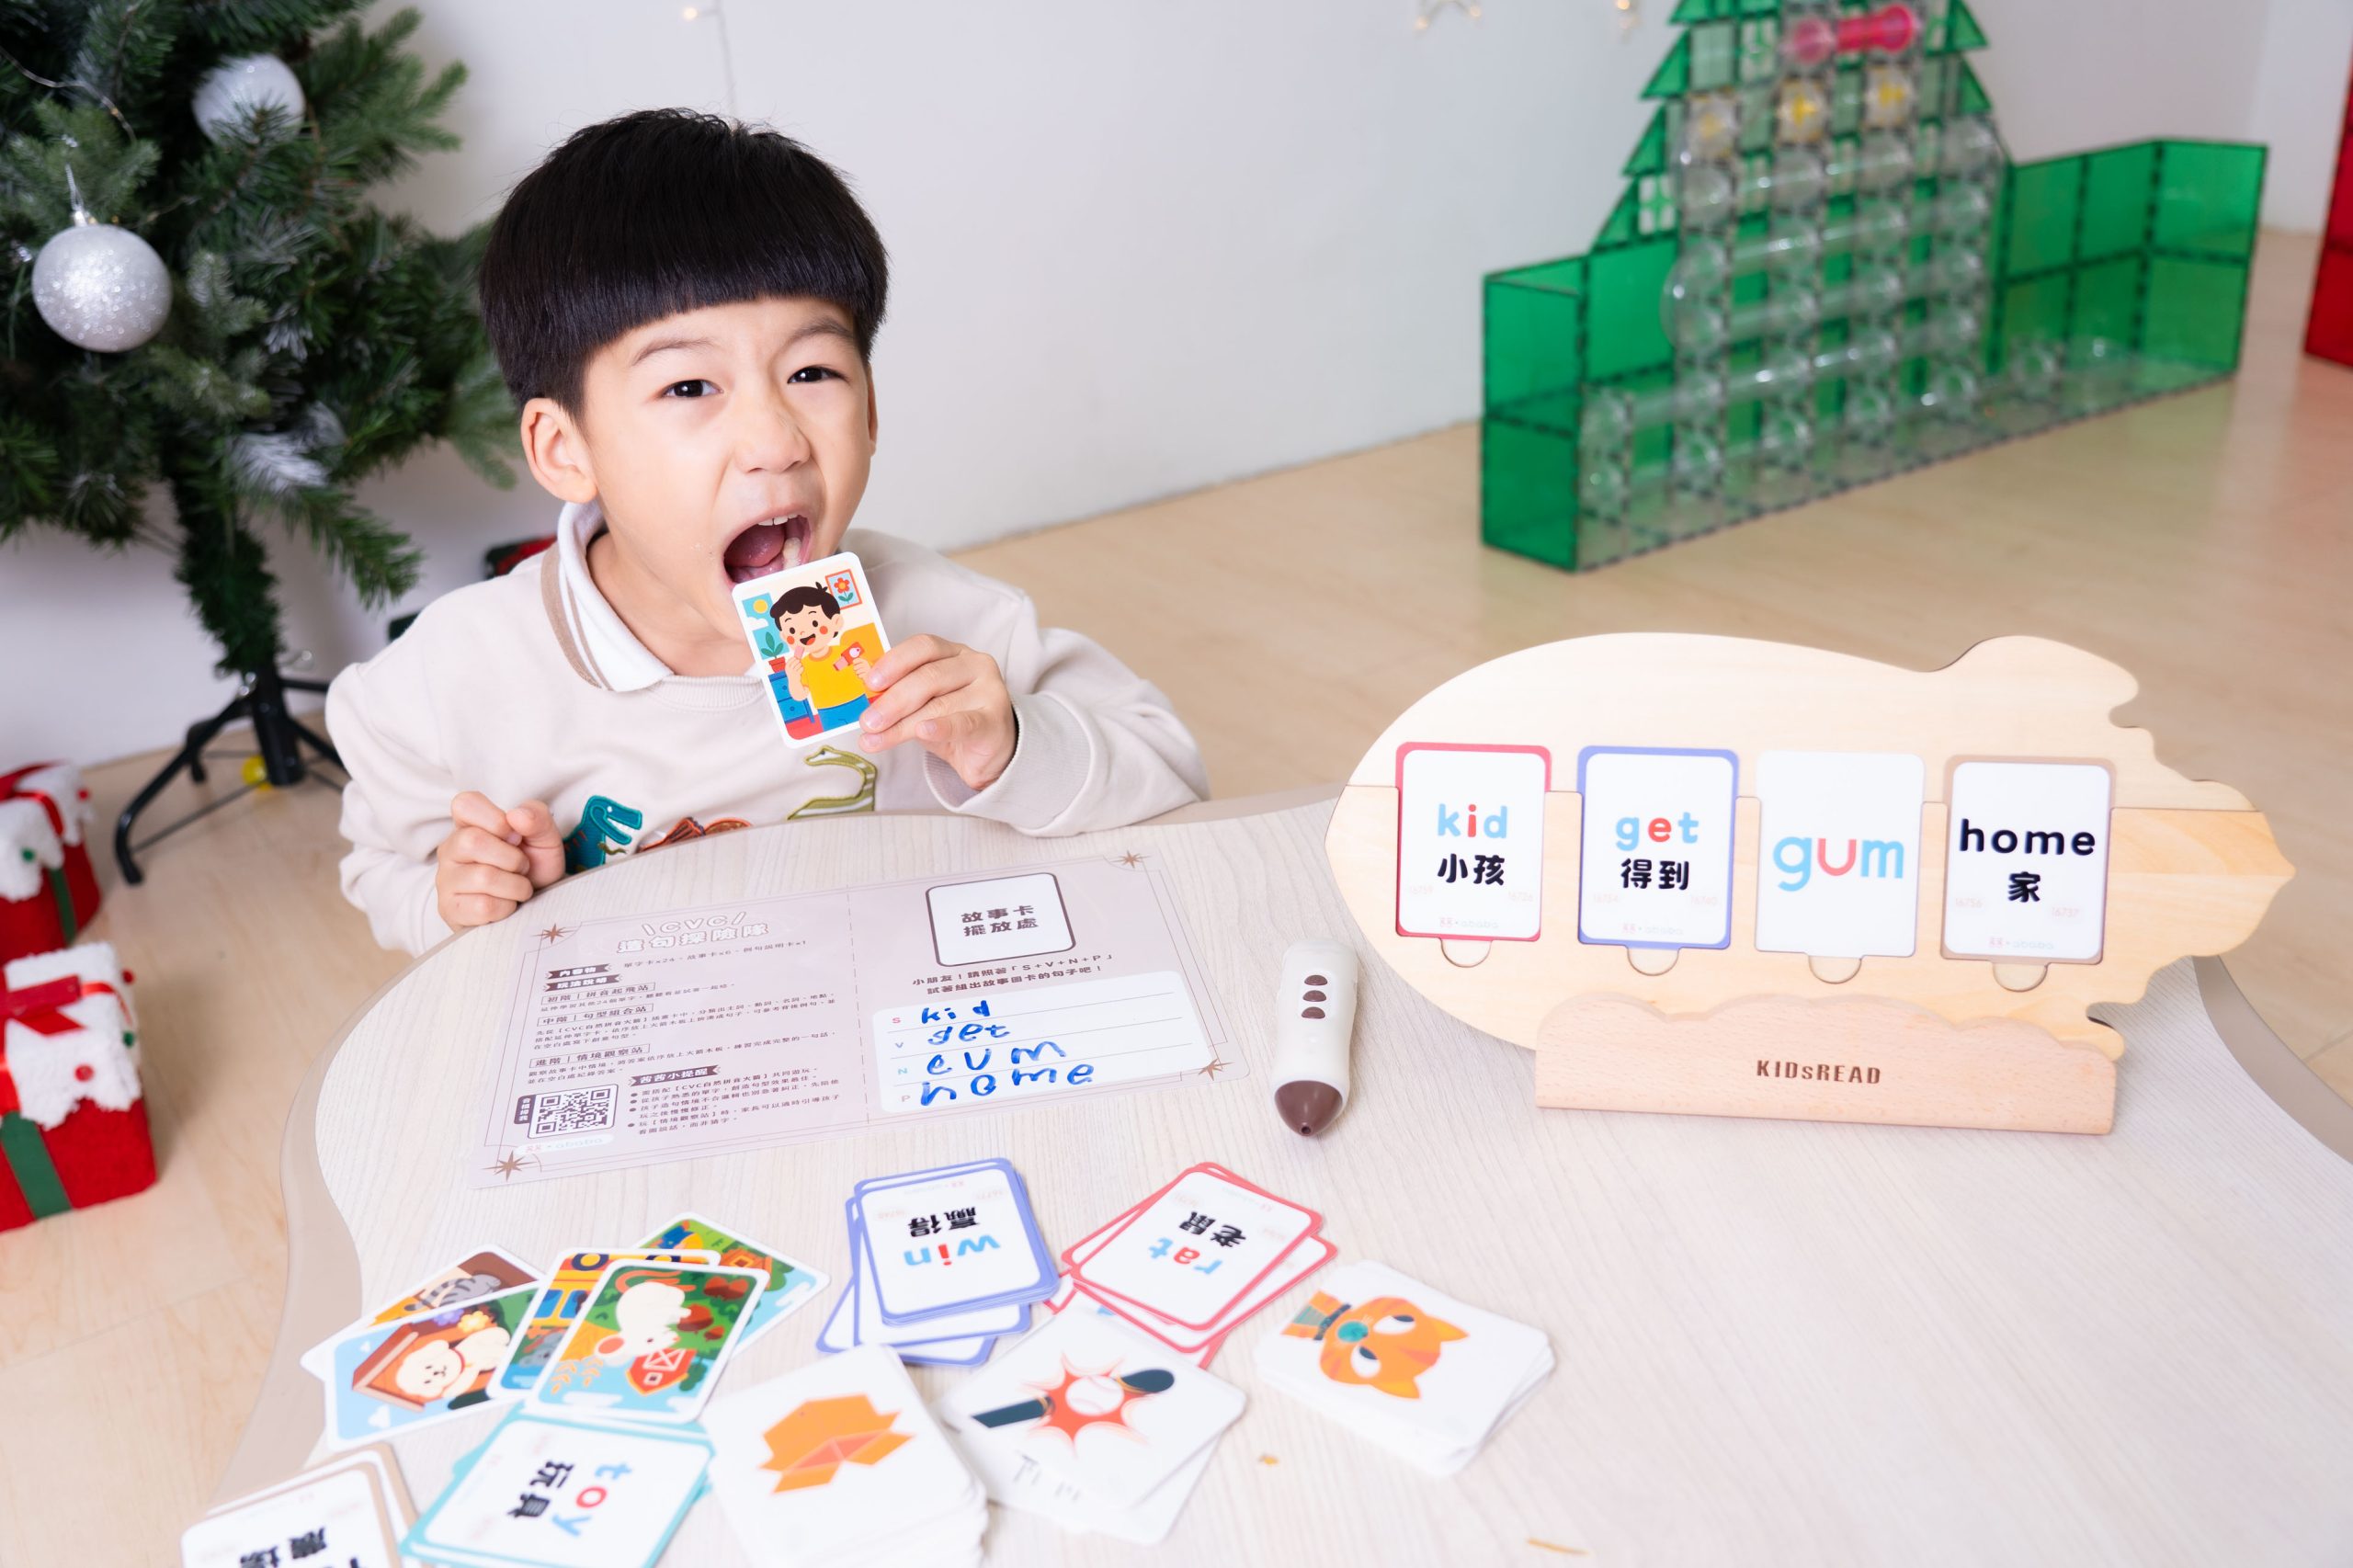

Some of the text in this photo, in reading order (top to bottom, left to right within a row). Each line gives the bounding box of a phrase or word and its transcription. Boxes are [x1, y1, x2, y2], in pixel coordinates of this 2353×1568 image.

[1438, 803, 1507, 839] kid
[1616, 812, 1699, 851] get
[1959, 818, 2096, 856] home
[1438, 853, 1506, 886] 小孩
[1620, 858, 1689, 891] 得到
[1773, 836, 1904, 892] gum
[2007, 871, 2040, 903] 家
[961, 905, 1034, 923] 故事卡
[963, 918, 1039, 937] 擺放處
[617, 923, 768, 953] 造句探險隊
[921, 1000, 991, 1024] kid
[897, 1067, 908, 1075] N
[1756, 1060, 1881, 1085] KIDsREAD
[902, 1095, 911, 1103] P
[907, 1207, 980, 1237] 贏得
[1178, 1211, 1246, 1248] 老鼠
[904, 1235, 1000, 1266] win
[1149, 1237, 1222, 1275] rat
[506, 1460, 574, 1518] 玩具
[551, 1461, 633, 1538] toy
